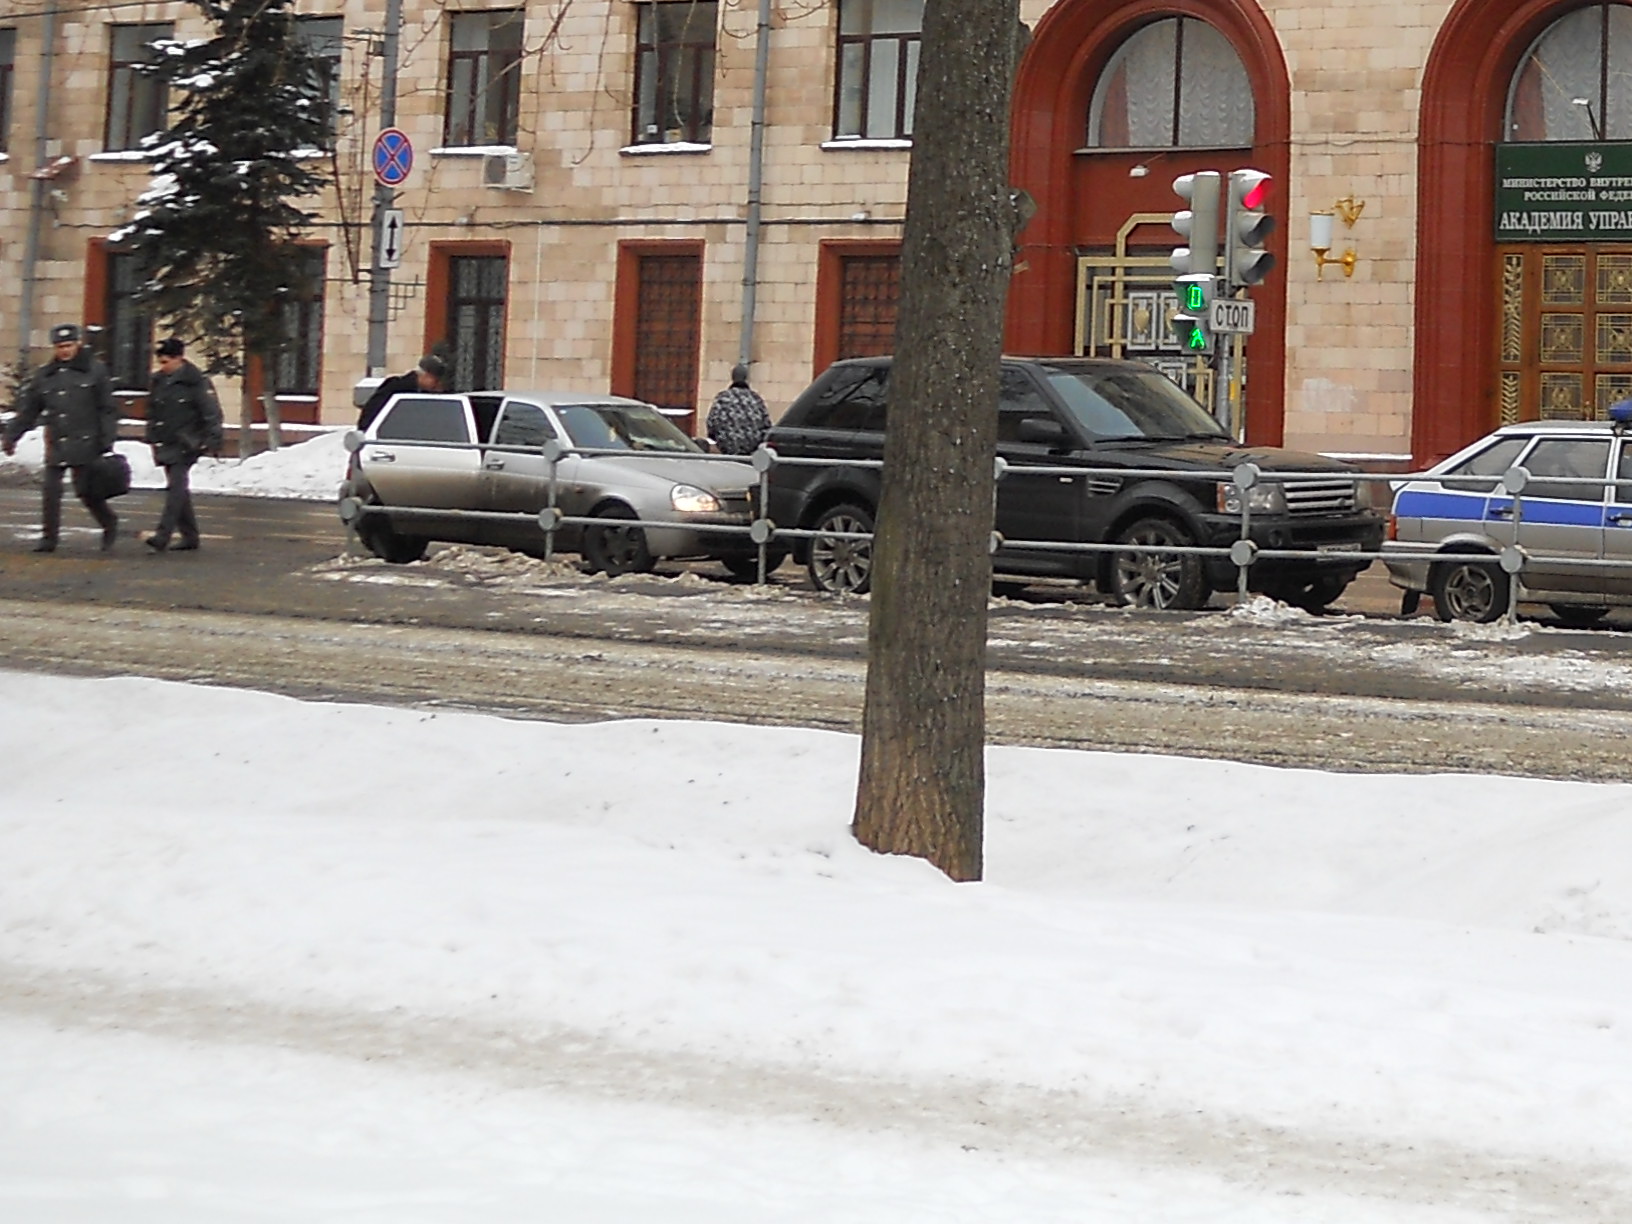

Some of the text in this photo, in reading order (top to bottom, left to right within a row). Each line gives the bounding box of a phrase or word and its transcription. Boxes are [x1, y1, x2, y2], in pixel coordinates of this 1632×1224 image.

[1502, 177, 1587, 188] МИНИСТЕРСТВО
[1523, 188, 1596, 202] РОССИЙСКОЙ
[1499, 211, 1584, 235] АКАДЕМИЯ
[1215, 304, 1249, 328] СТОП
